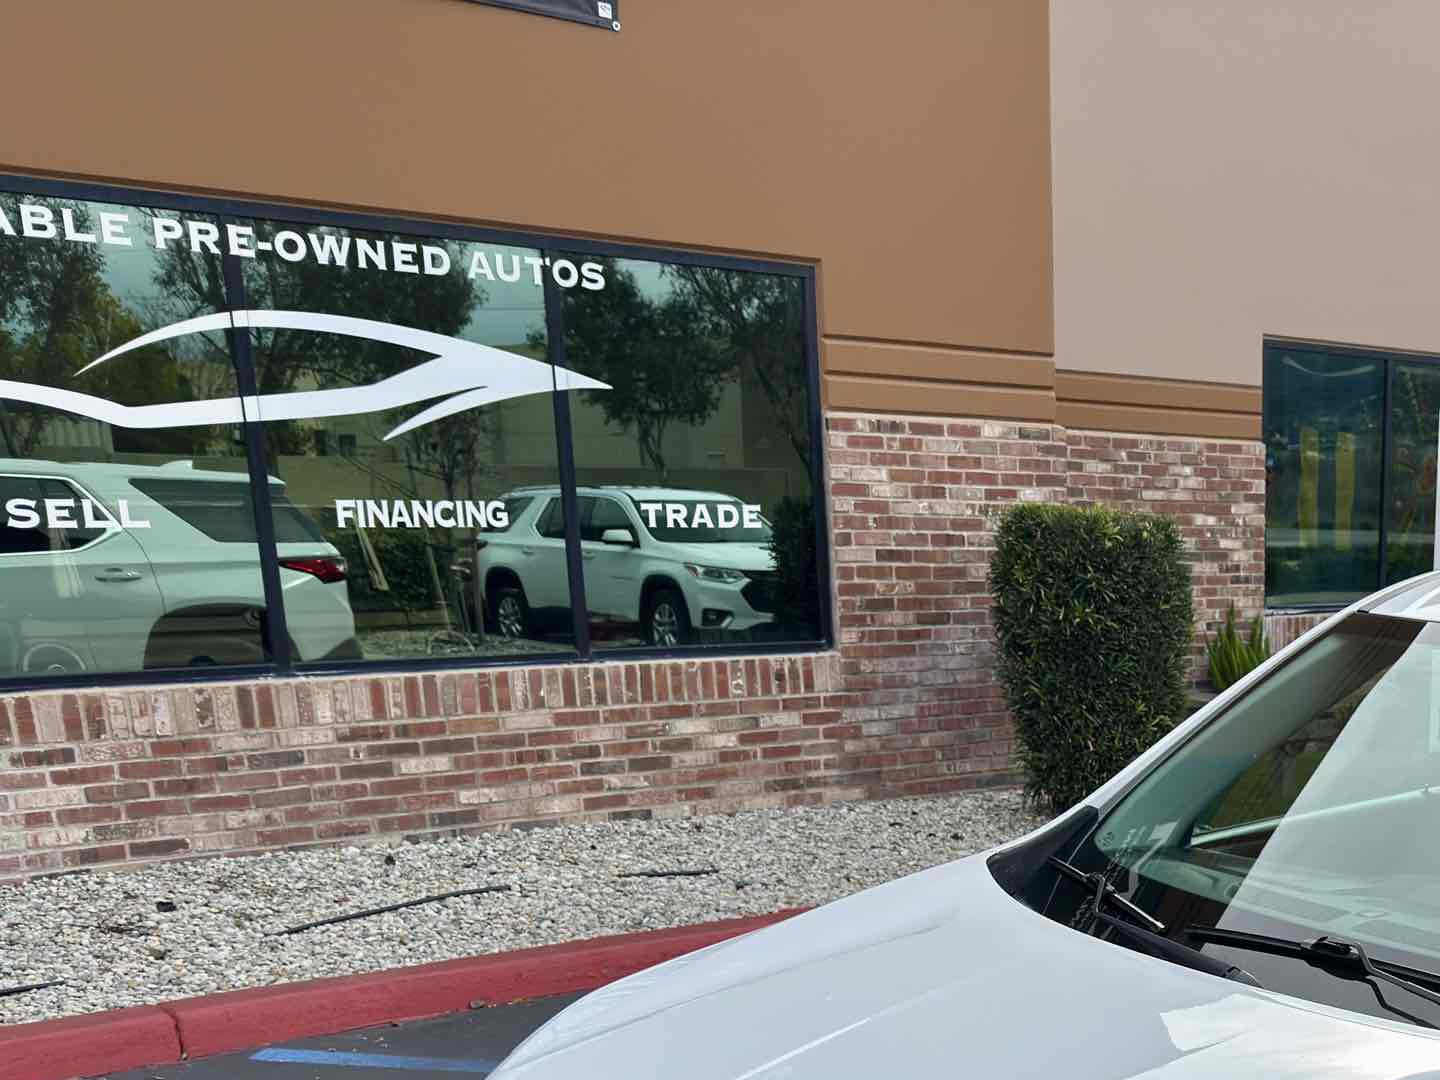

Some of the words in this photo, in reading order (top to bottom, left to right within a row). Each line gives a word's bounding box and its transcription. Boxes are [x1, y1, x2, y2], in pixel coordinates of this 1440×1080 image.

[152, 216, 451, 277] PRE-OWNED
[467, 251, 606, 291] AUTOS
[5, 498, 151, 529] SELL
[335, 499, 511, 529] FINANCING
[639, 502, 763, 529] TRADE
